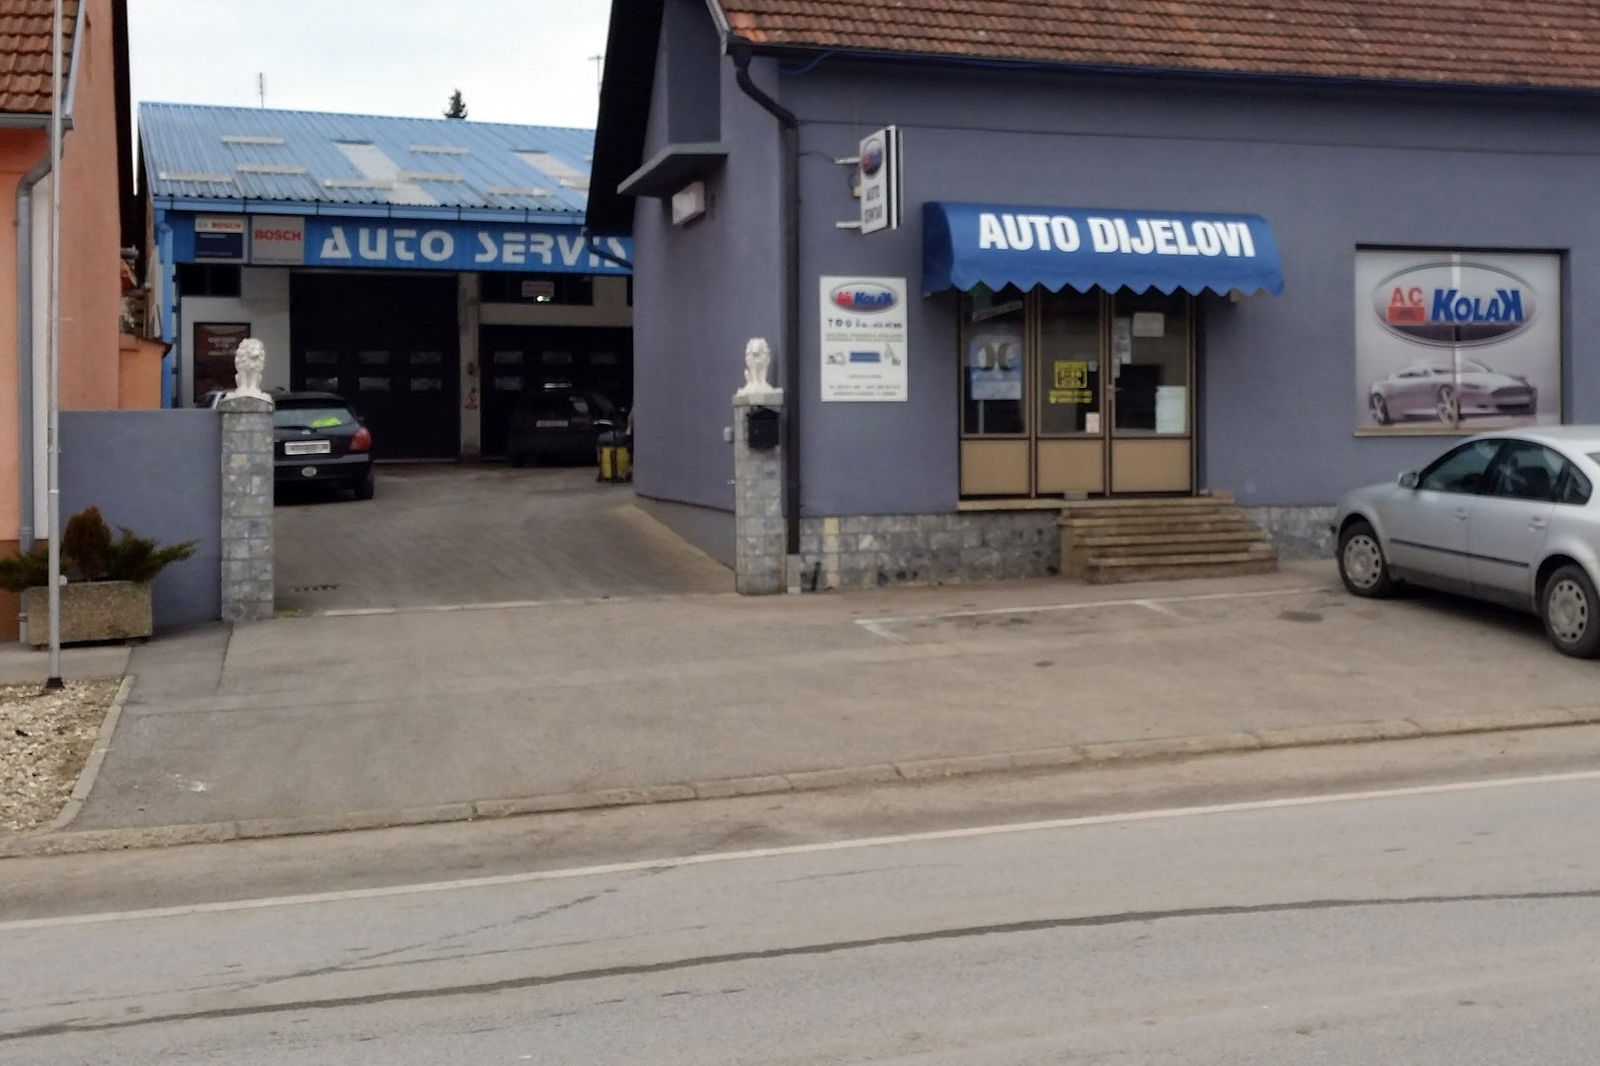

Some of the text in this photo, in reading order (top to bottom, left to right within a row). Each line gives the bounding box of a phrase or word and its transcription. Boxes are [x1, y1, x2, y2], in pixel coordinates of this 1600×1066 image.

[211, 221, 242, 230] BOSCH
[254, 229, 302, 241] BOSCH
[979, 213, 1256, 258] AUTO DIJELOVI
[319, 225, 626, 268] AUTO SERVIS
[1391, 286, 1424, 307] AC
